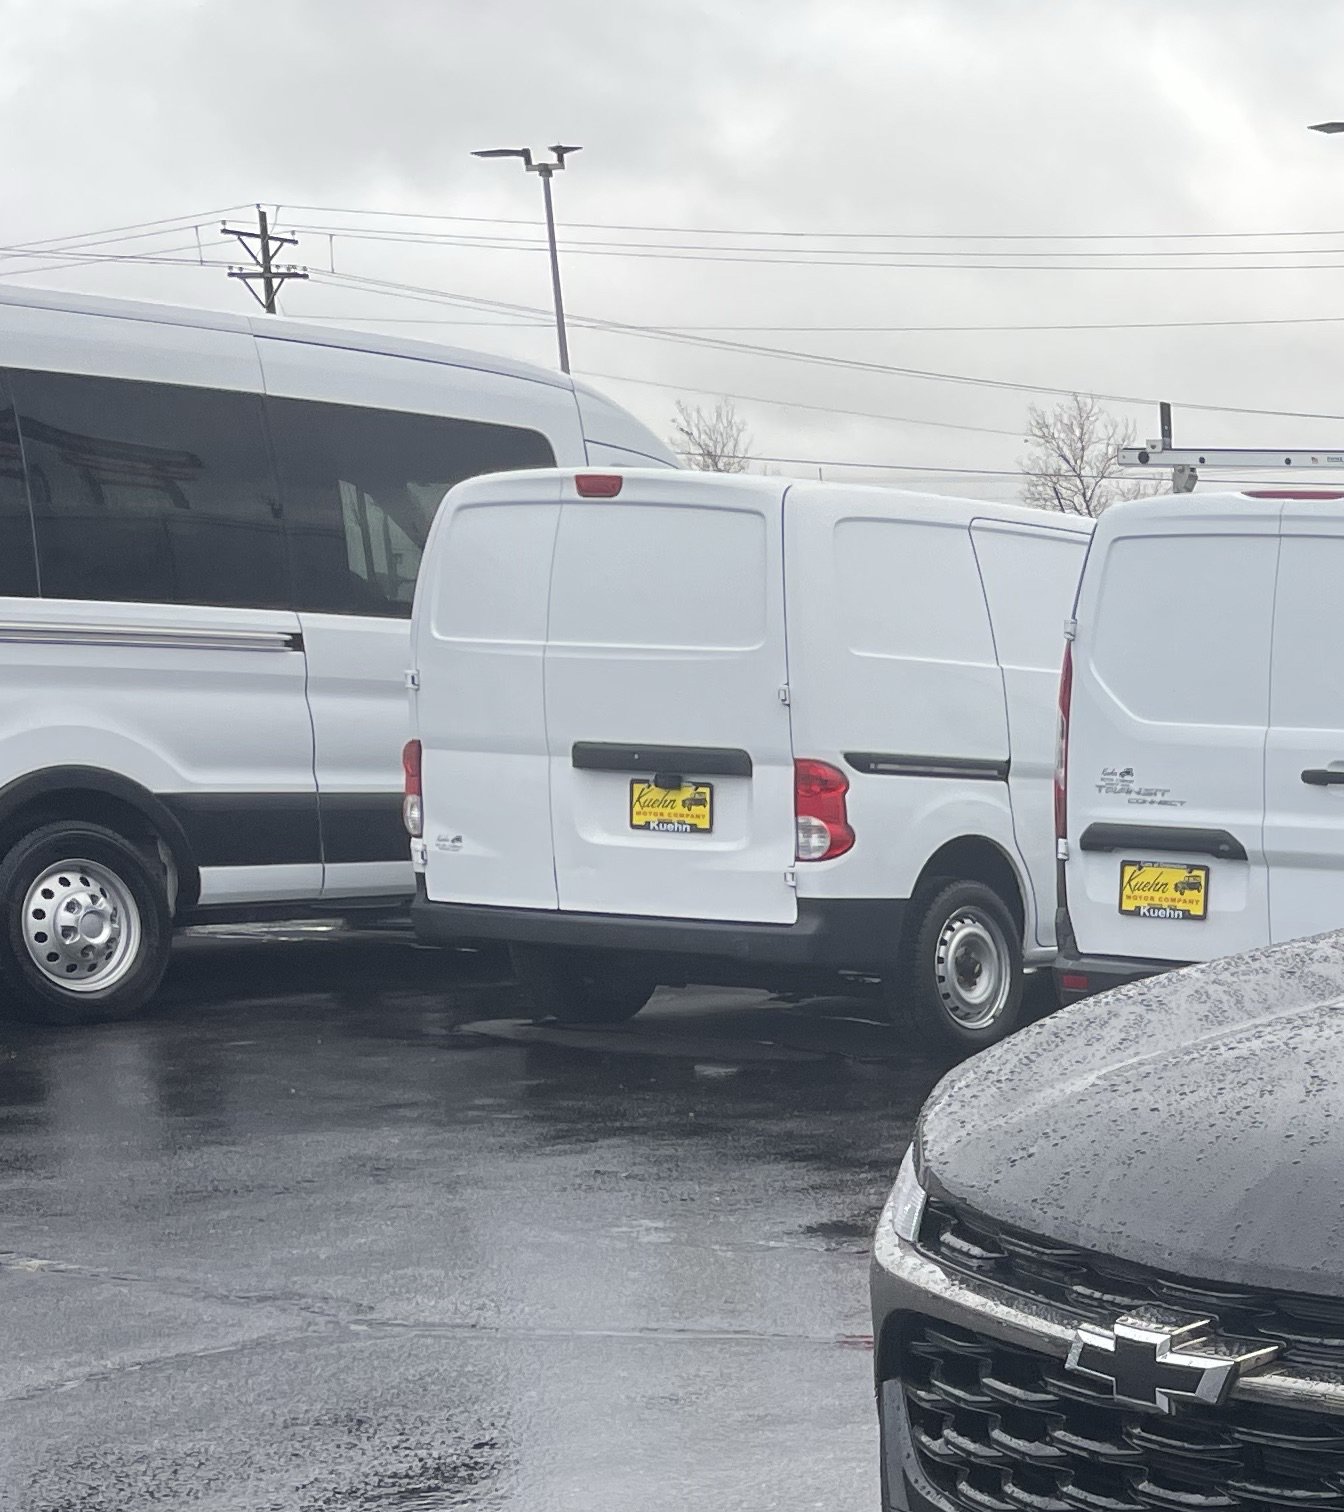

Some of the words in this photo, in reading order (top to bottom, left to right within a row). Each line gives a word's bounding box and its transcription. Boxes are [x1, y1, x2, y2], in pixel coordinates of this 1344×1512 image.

[633, 787, 677, 810] Kuehn
[635, 810, 664, 818] MOTOR
[649, 820, 691, 833] Kuehn
[1122, 869, 1169, 894] Kuehn
[1125, 894, 1155, 902] MOTOR
[1158, 896, 1201, 906] COMPANY
[1139, 905, 1184, 919] Kuehn
